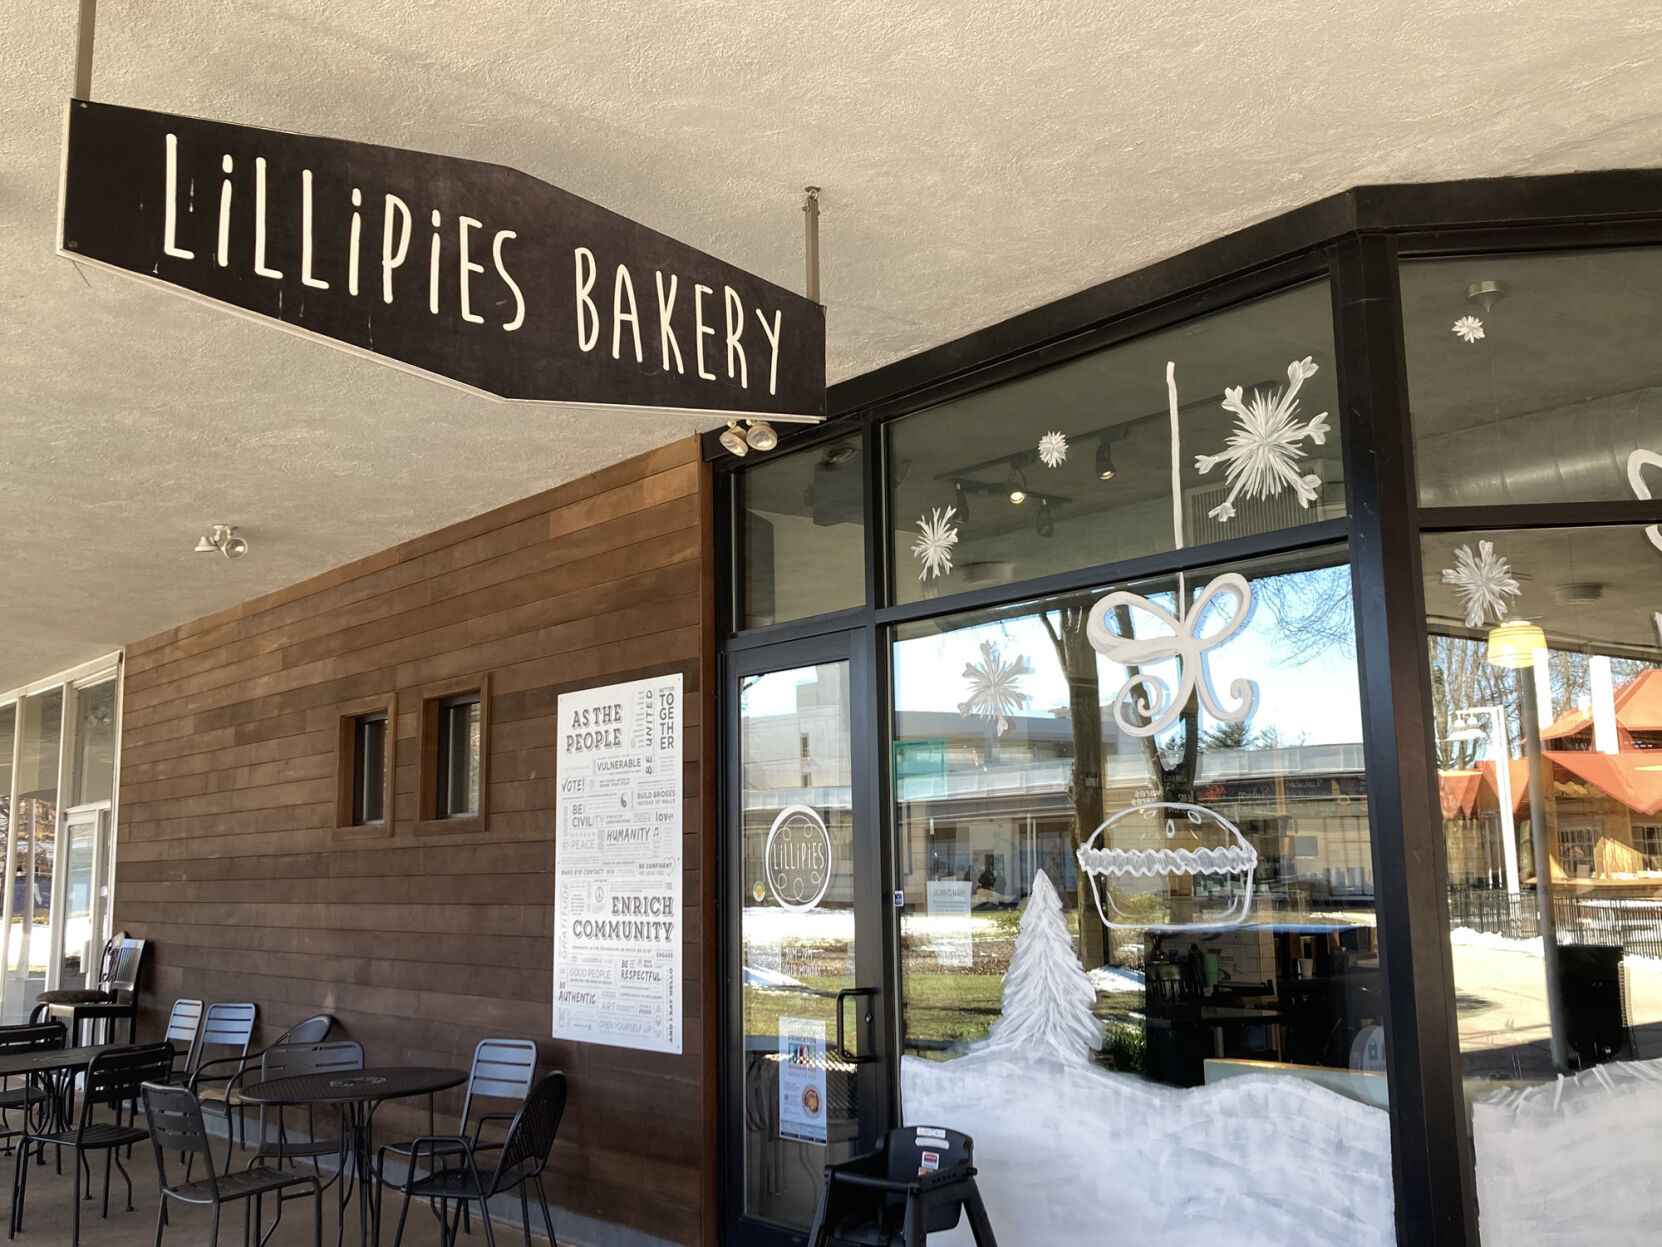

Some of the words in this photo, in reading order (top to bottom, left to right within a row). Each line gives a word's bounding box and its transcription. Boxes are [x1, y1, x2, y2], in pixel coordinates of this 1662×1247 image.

[574, 246, 782, 396] BAKERY
[659, 693, 674, 706] TO
[572, 709, 591, 729] AS
[593, 704, 623, 727] THE
[566, 728, 623, 754] PEOPLE
[597, 758, 641, 772] VULNERABLE
[646, 755, 653, 775] BE
[562, 777, 585, 793] VOTE!
[572, 804, 583, 815] BE
[607, 827, 650, 842] HUMANITY
[612, 896, 674, 917] ENRICH
[573, 919, 674, 943] COMMUNITY
[621, 969, 662, 982] RESPECTFUL
[558, 990, 596, 1005] AUTHENTIC
